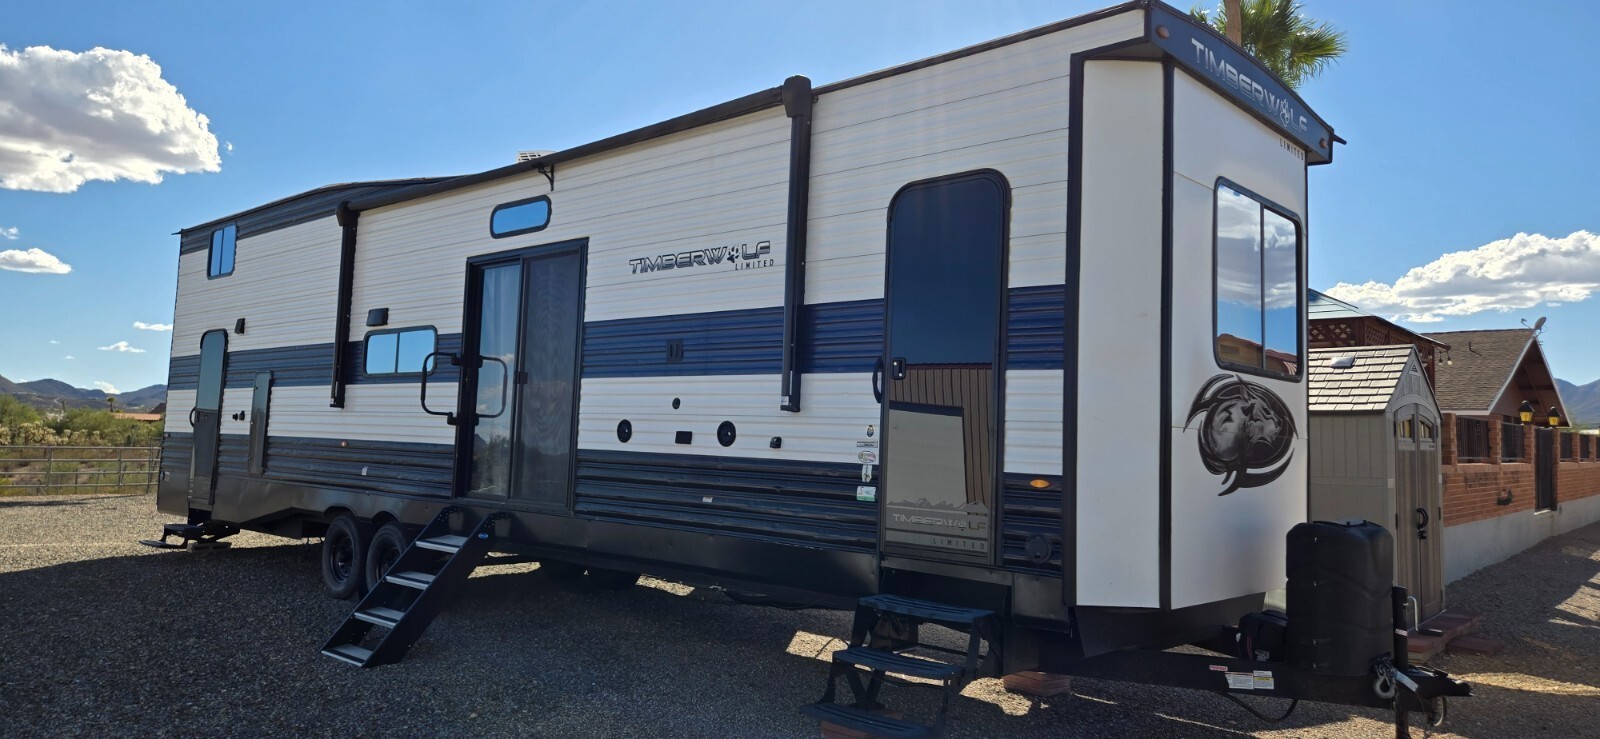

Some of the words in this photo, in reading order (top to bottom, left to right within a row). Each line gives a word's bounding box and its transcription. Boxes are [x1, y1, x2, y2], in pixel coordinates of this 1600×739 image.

[1279, 137, 1305, 161] LIMITED
[735, 258, 775, 271] LIMITED
[932, 537, 986, 550] LIMITED
